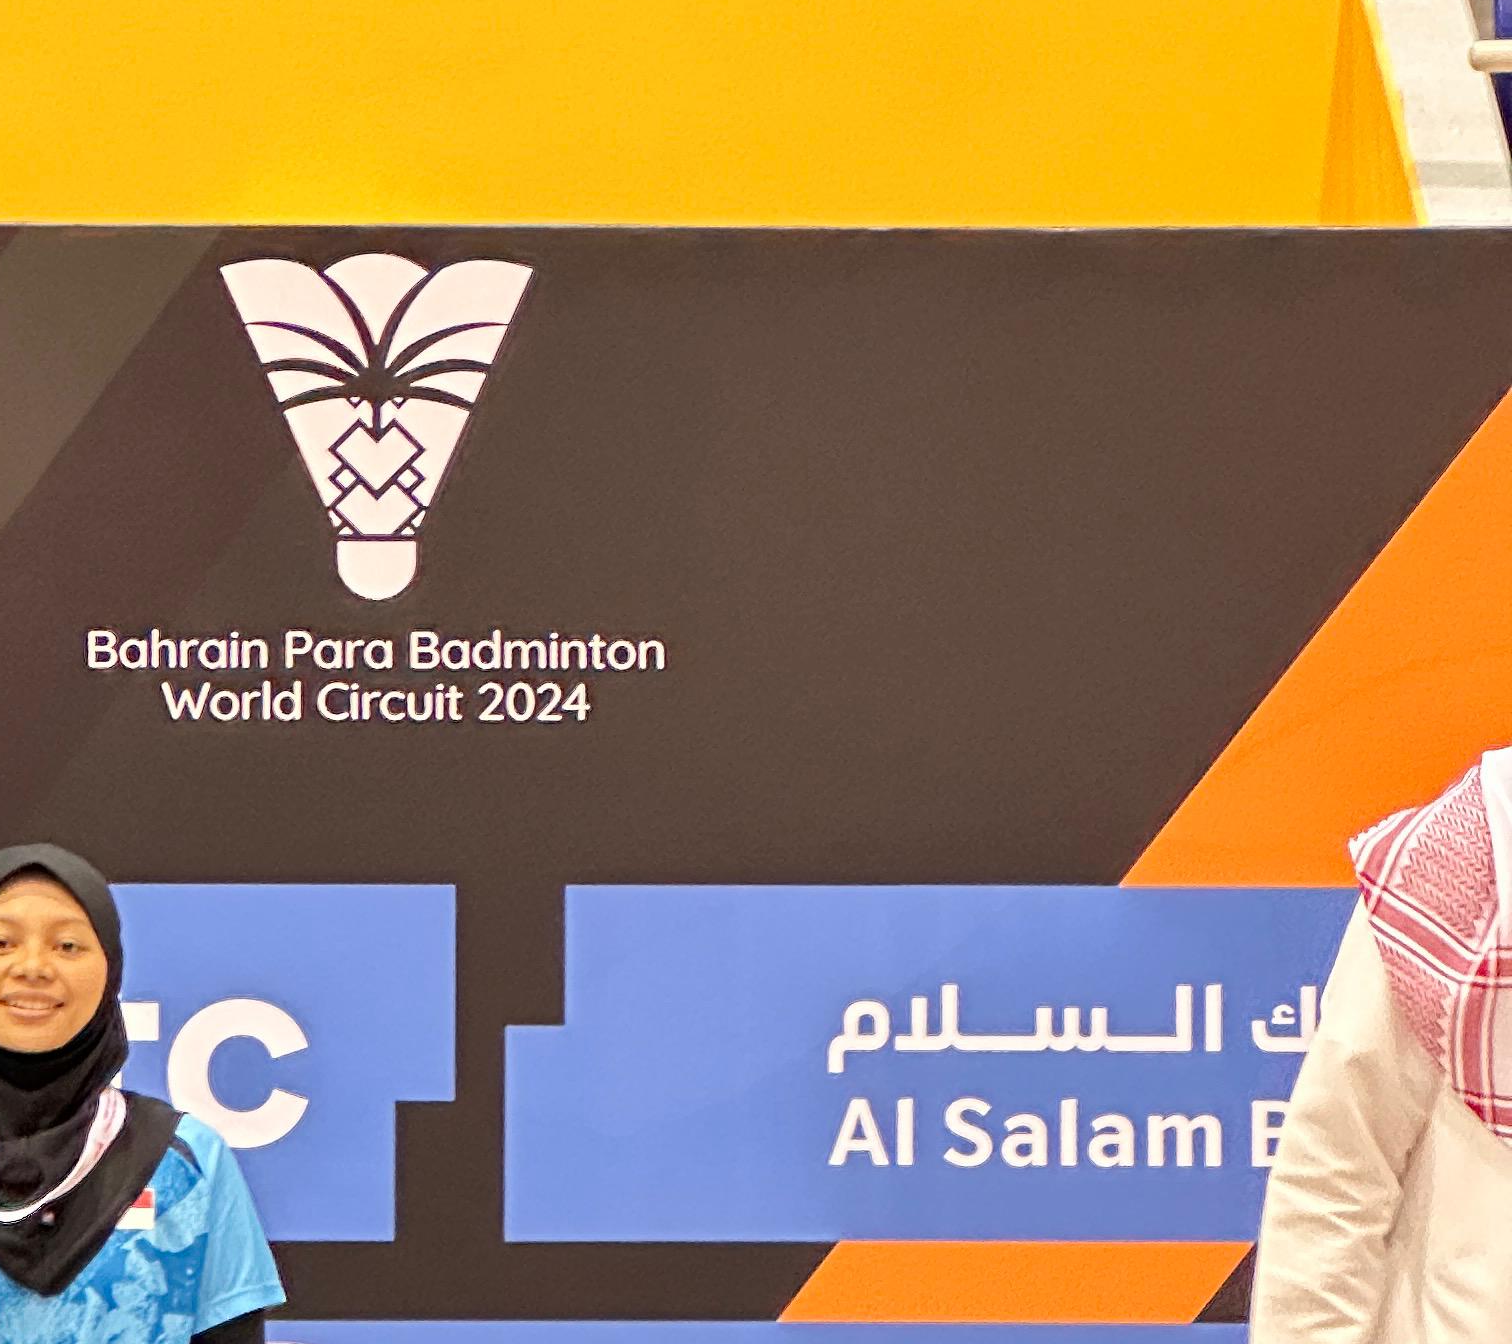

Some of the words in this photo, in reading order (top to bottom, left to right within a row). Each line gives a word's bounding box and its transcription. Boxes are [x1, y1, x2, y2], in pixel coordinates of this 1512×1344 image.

[88, 629, 268, 670] Bahrain
[285, 630, 393, 670] Para
[409, 629, 665, 670] Badminton
[162, 681, 301, 721] World
[317, 681, 463, 721] Circuit
[478, 682, 591, 721] 2024
[828, 984, 1222, 1074] السلام
[828, 1098, 914, 1166] Al
[943, 1097, 1222, 1168] Salam
